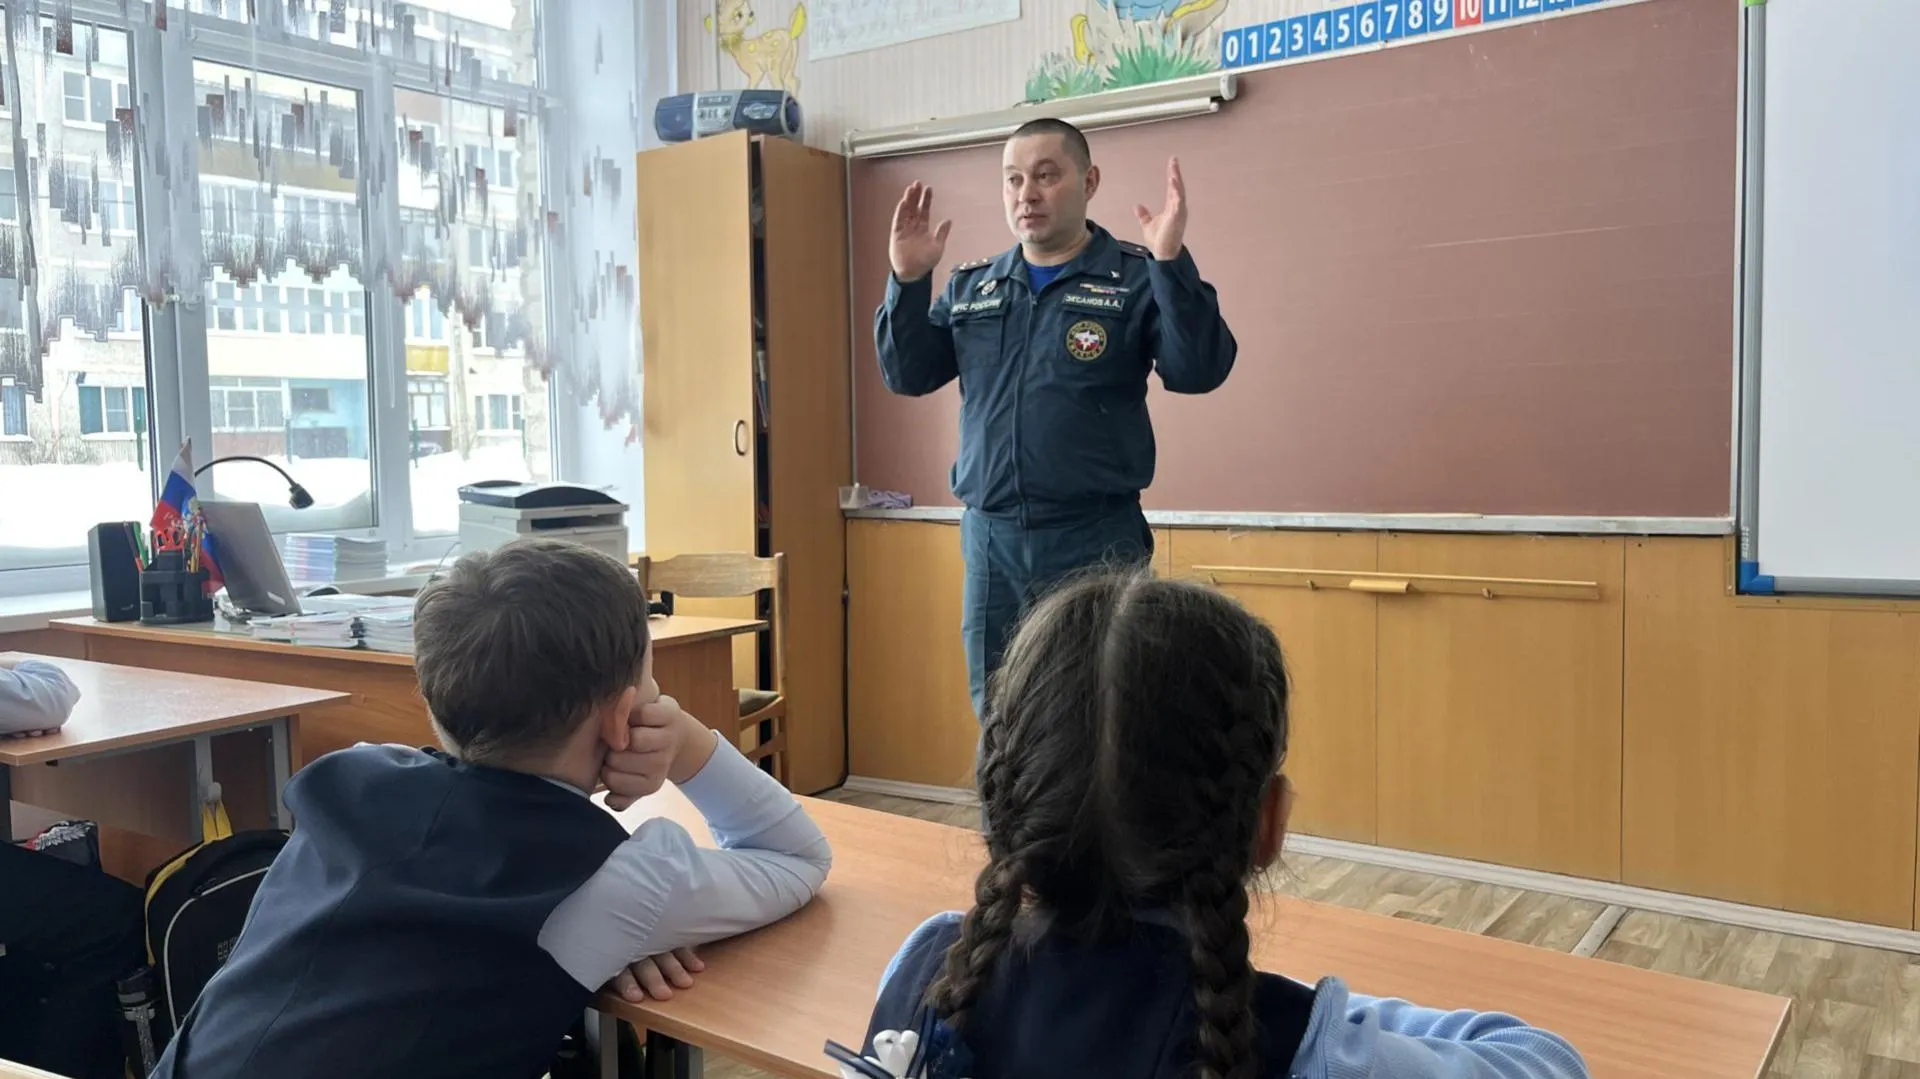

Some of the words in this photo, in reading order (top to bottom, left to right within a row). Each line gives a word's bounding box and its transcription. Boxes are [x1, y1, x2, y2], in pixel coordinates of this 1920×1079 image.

[1225, 35, 1239, 62] 0
[1248, 32, 1258, 58] 1
[1268, 27, 1282, 55] 2
[1291, 23, 1304, 51] 3
[1313, 18, 1328, 46] 4
[1337, 13, 1350, 43] 5
[1360, 8, 1375, 38] 6
[1384, 4, 1399, 34] 7
[1408, 0, 1423, 29] 8
[1433, 0, 1448, 25] 9
[1459, 0, 1480, 21] 10
